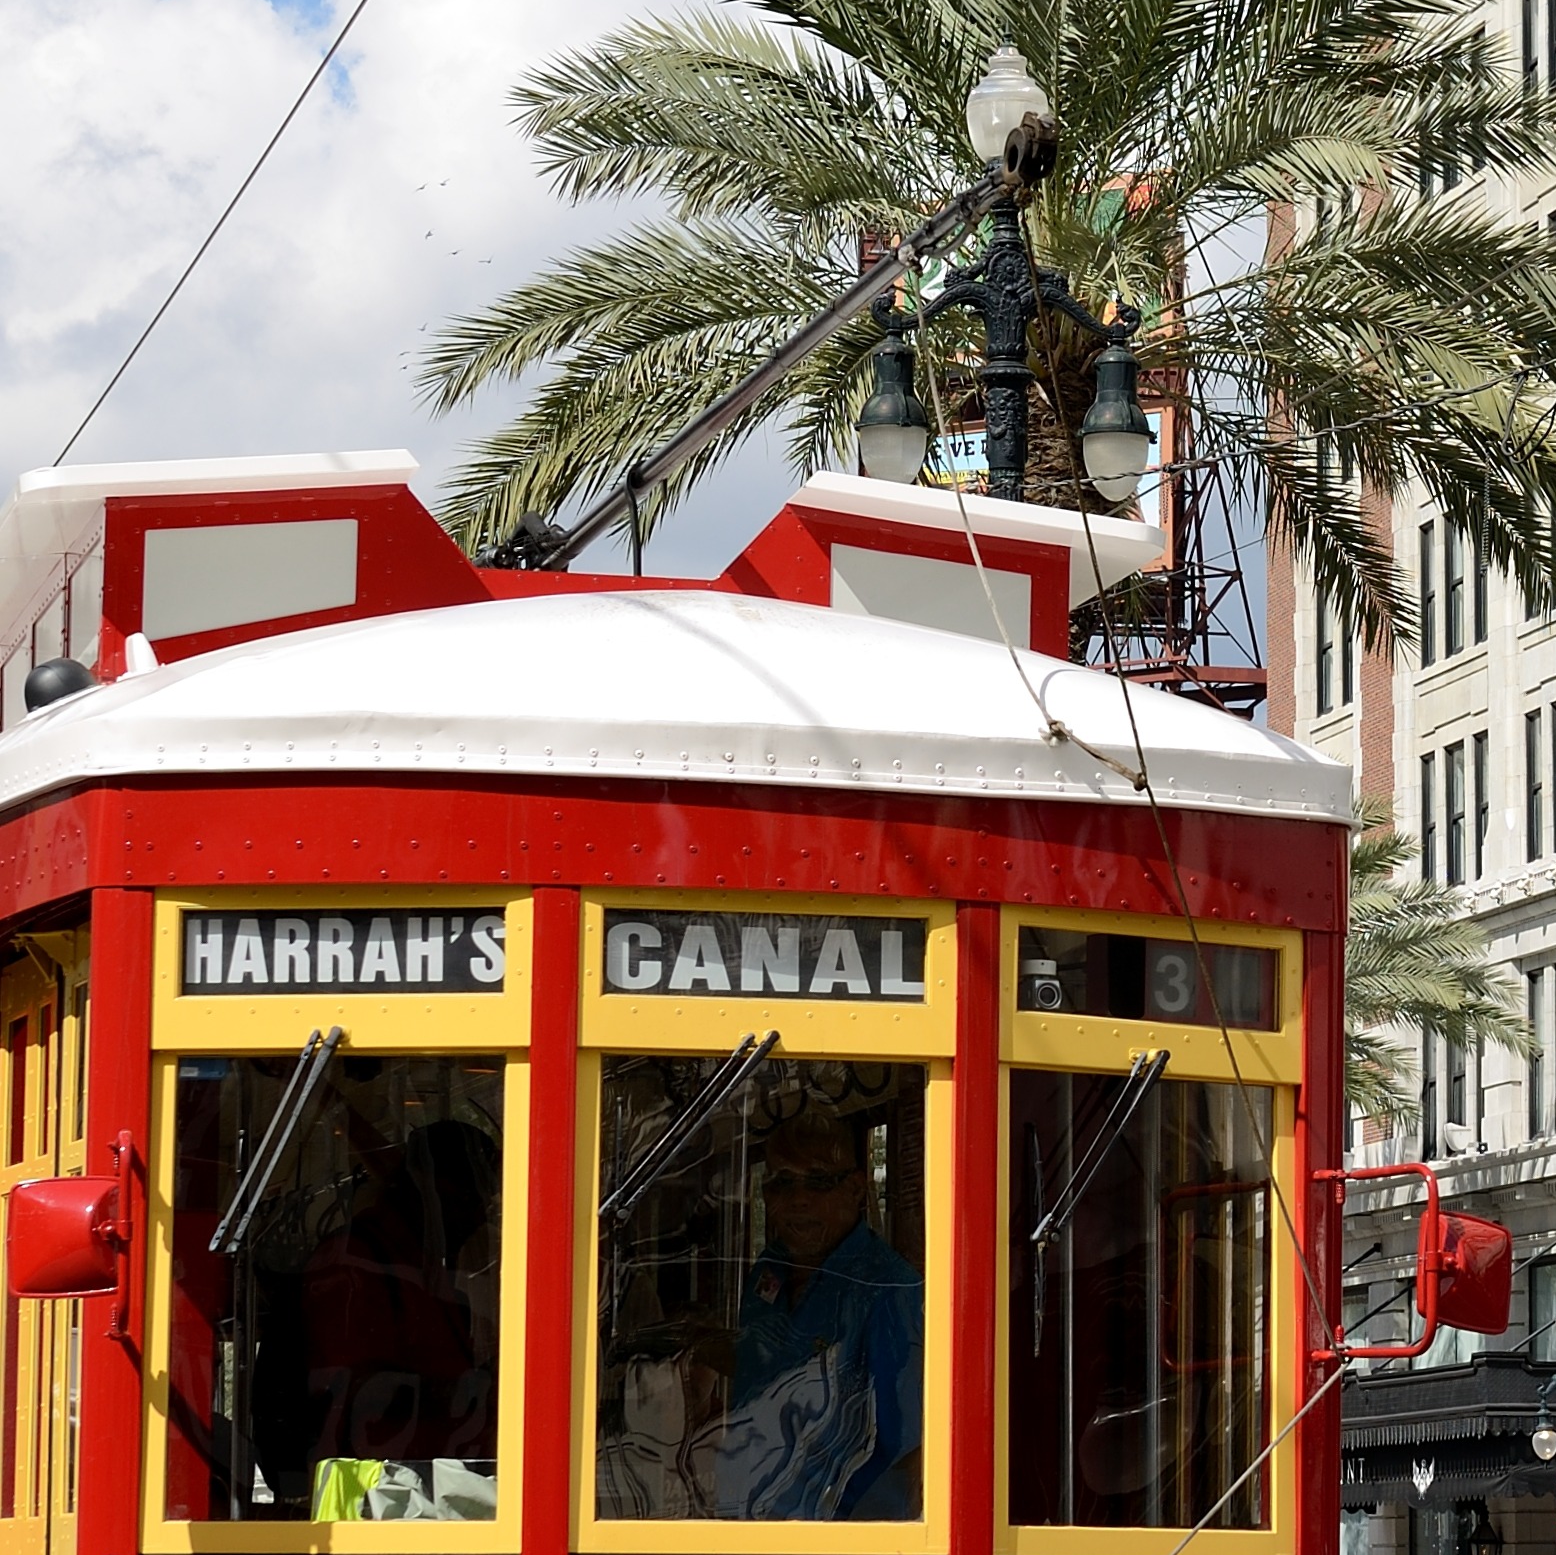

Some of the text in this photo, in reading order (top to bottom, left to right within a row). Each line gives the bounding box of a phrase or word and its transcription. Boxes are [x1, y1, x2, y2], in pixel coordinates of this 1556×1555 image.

[185, 915, 505, 985] HARRAH'S
[605, 922, 924, 996] CANAL
[1154, 954, 1190, 1012] 3
